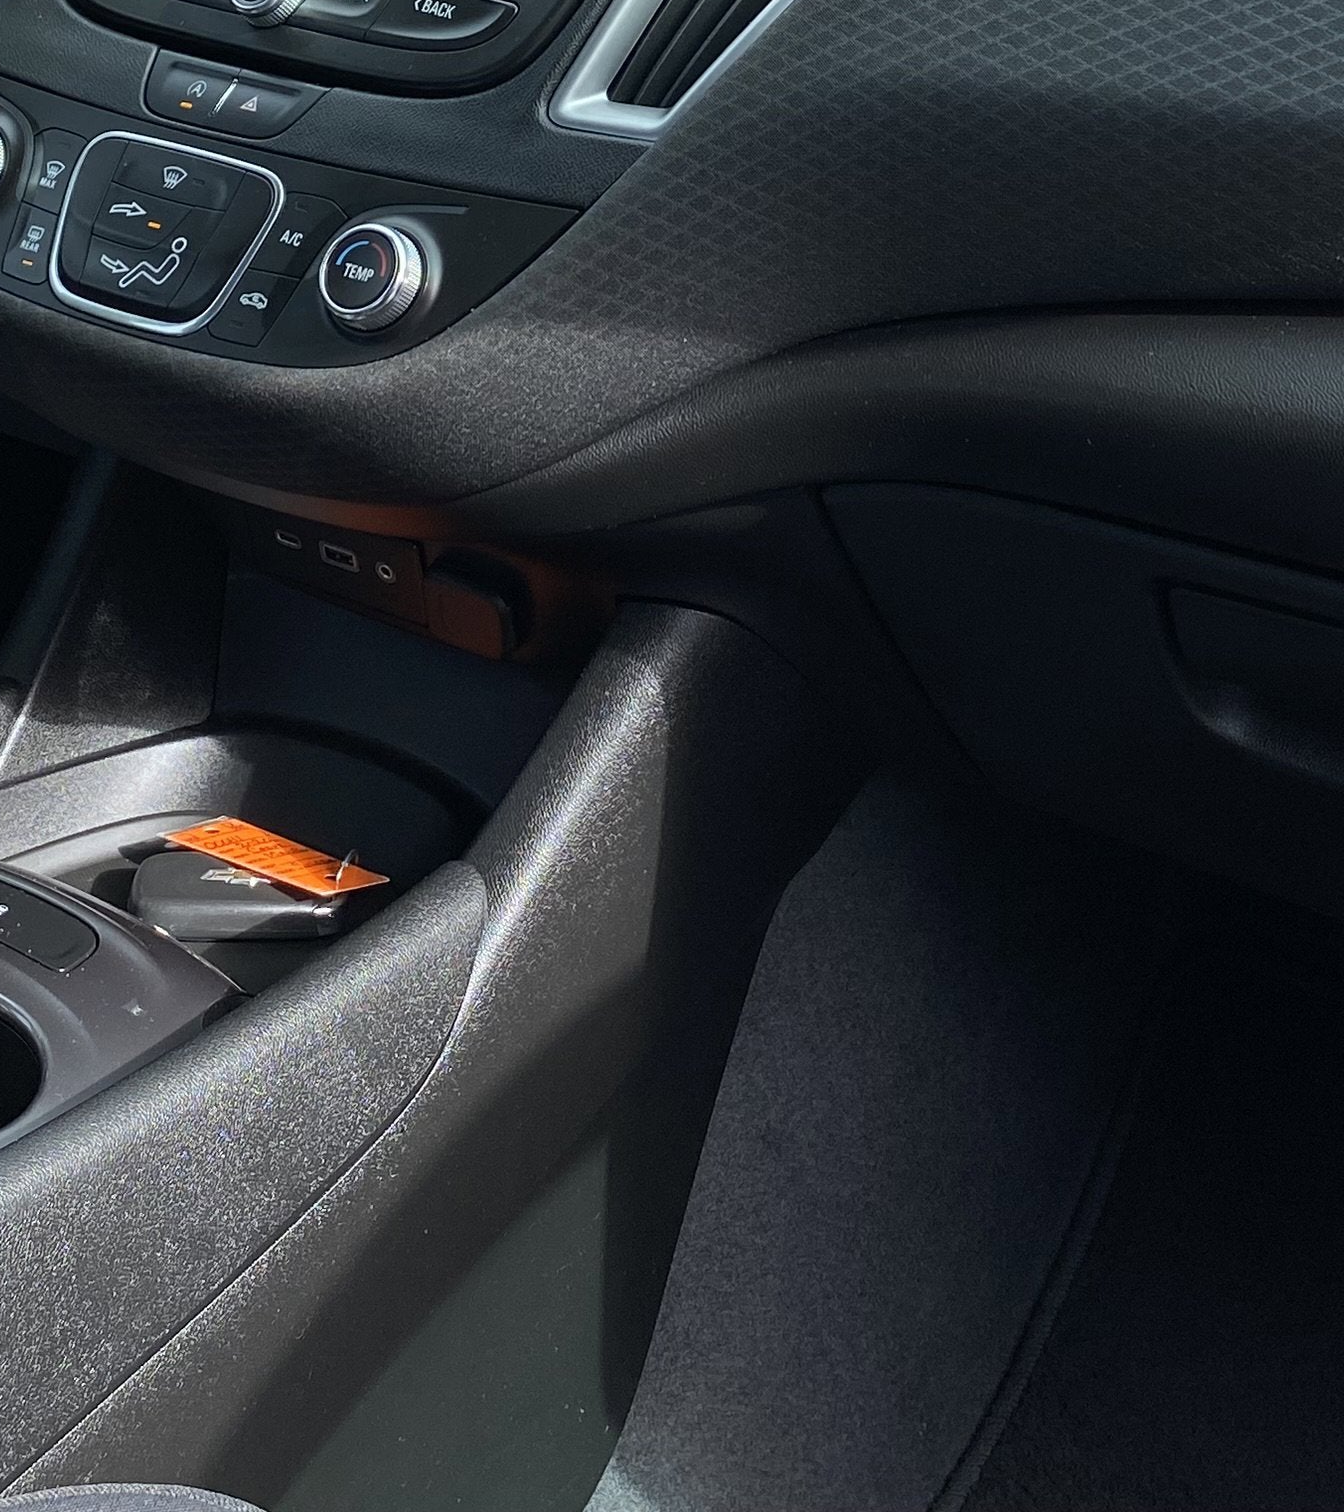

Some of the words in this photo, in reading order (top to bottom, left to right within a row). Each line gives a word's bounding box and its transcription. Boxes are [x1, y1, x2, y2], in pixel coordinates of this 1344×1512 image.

[39, 176, 57, 189] MAX
[19, 239, 40, 253] REAR
[279, 229, 304, 247] A/C
[343, 262, 375, 282] TEMP
